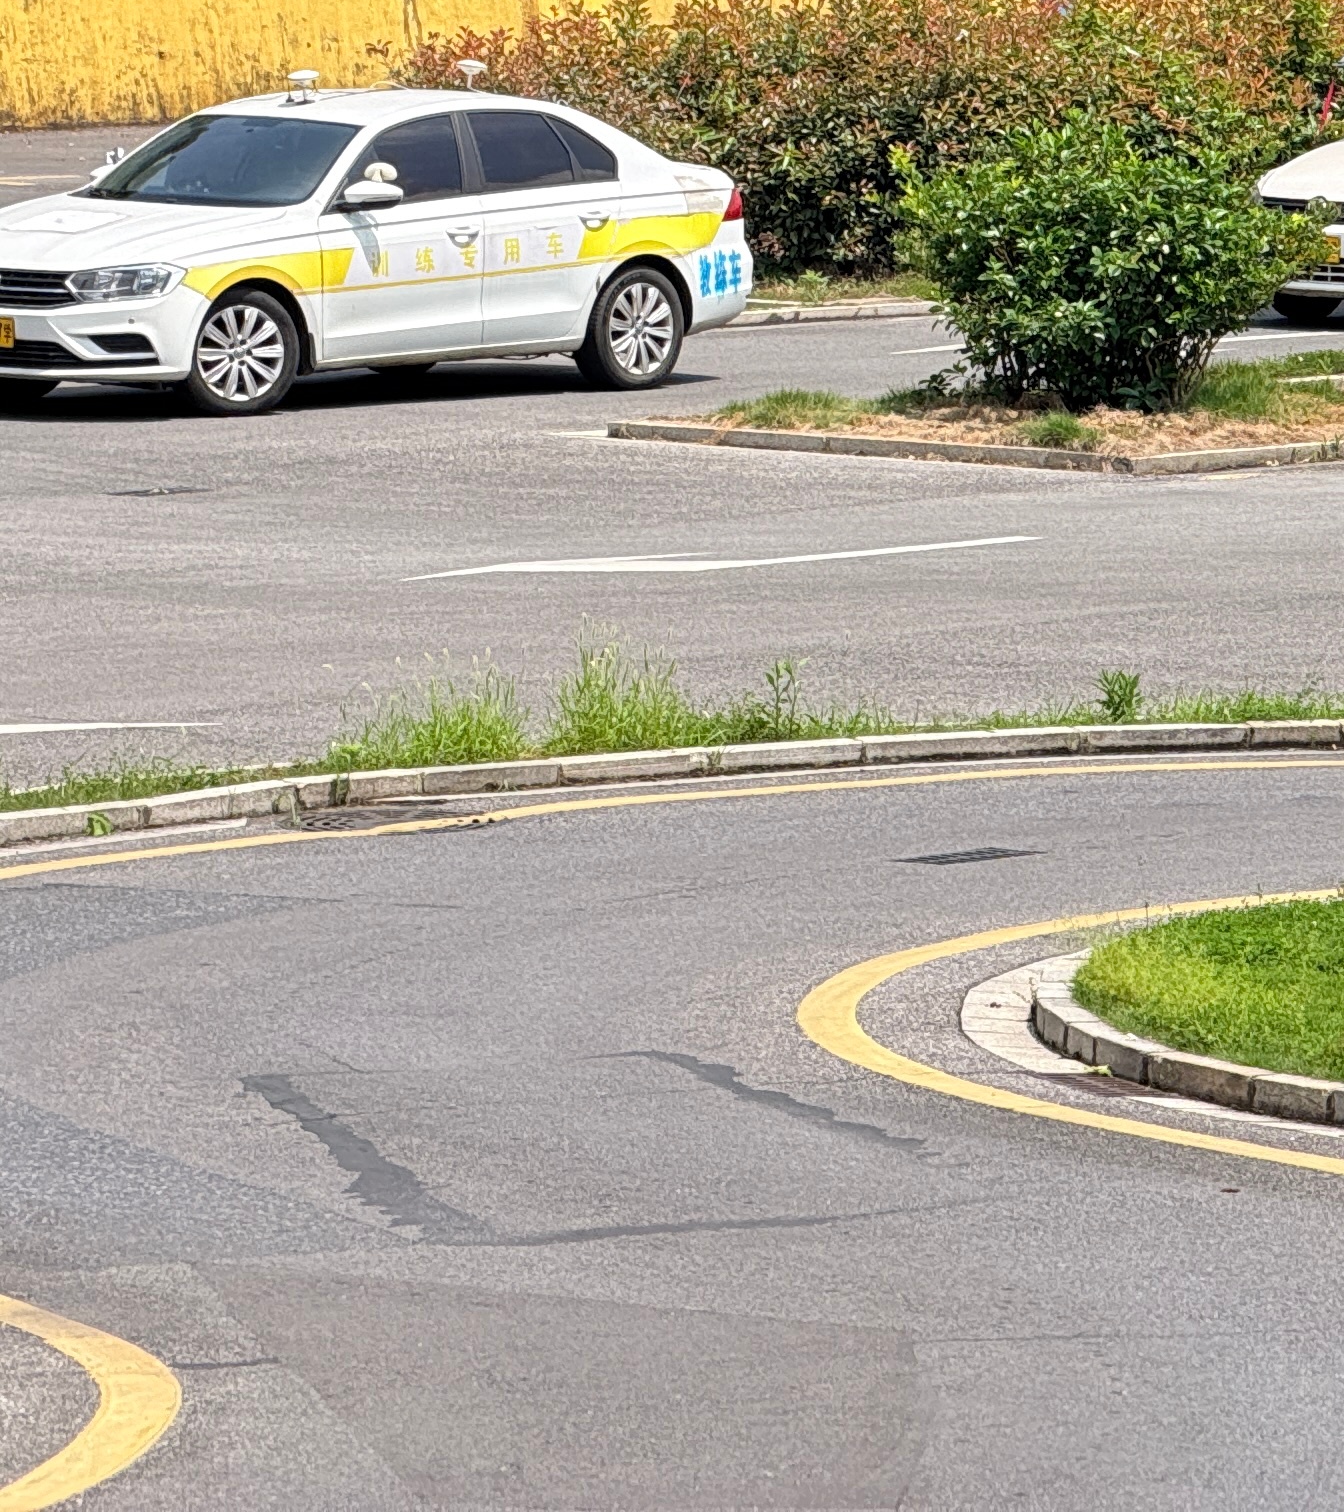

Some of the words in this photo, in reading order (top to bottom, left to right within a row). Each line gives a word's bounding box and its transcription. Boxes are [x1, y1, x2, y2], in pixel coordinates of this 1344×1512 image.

[372, 232, 564, 277] 训练专用车
